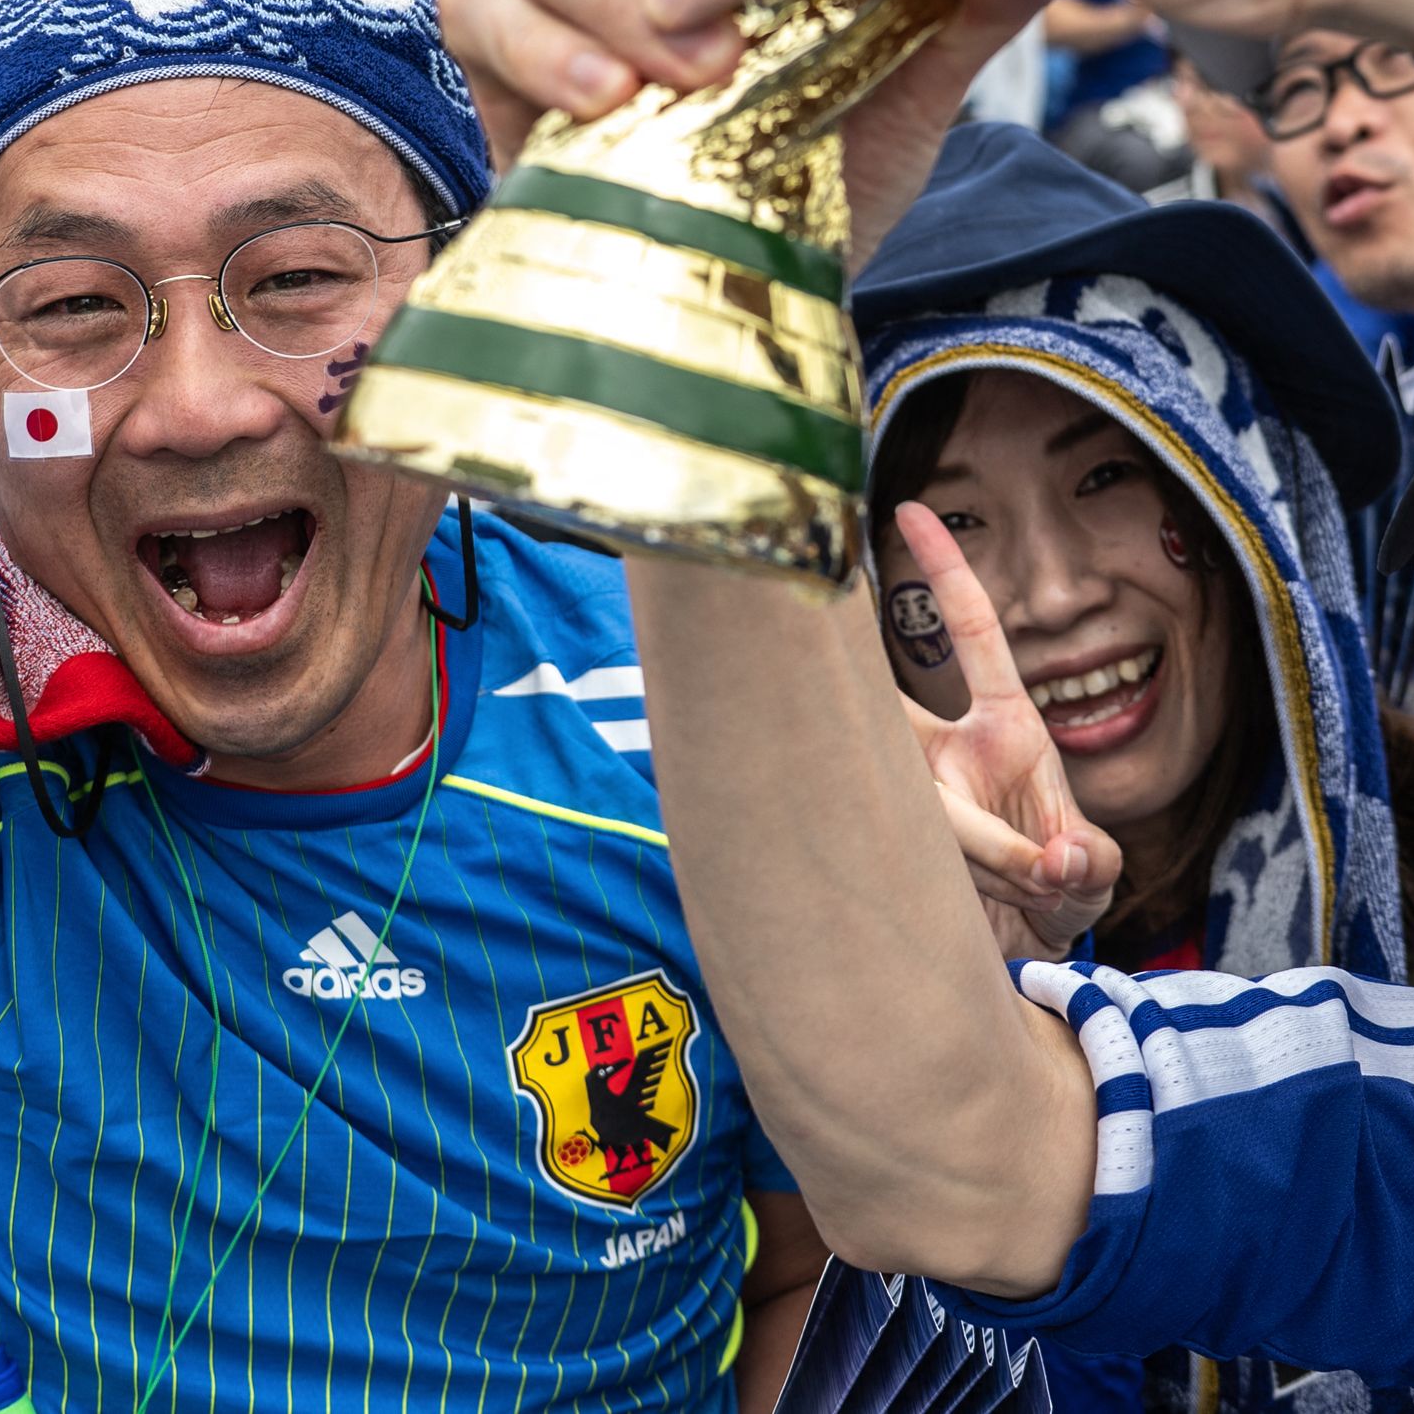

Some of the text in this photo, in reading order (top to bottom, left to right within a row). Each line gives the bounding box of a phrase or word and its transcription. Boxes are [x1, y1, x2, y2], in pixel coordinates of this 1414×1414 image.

[282, 962, 427, 1000] adidas
[543, 1000, 671, 1067] JFA
[599, 1209, 687, 1269] JAPAN
